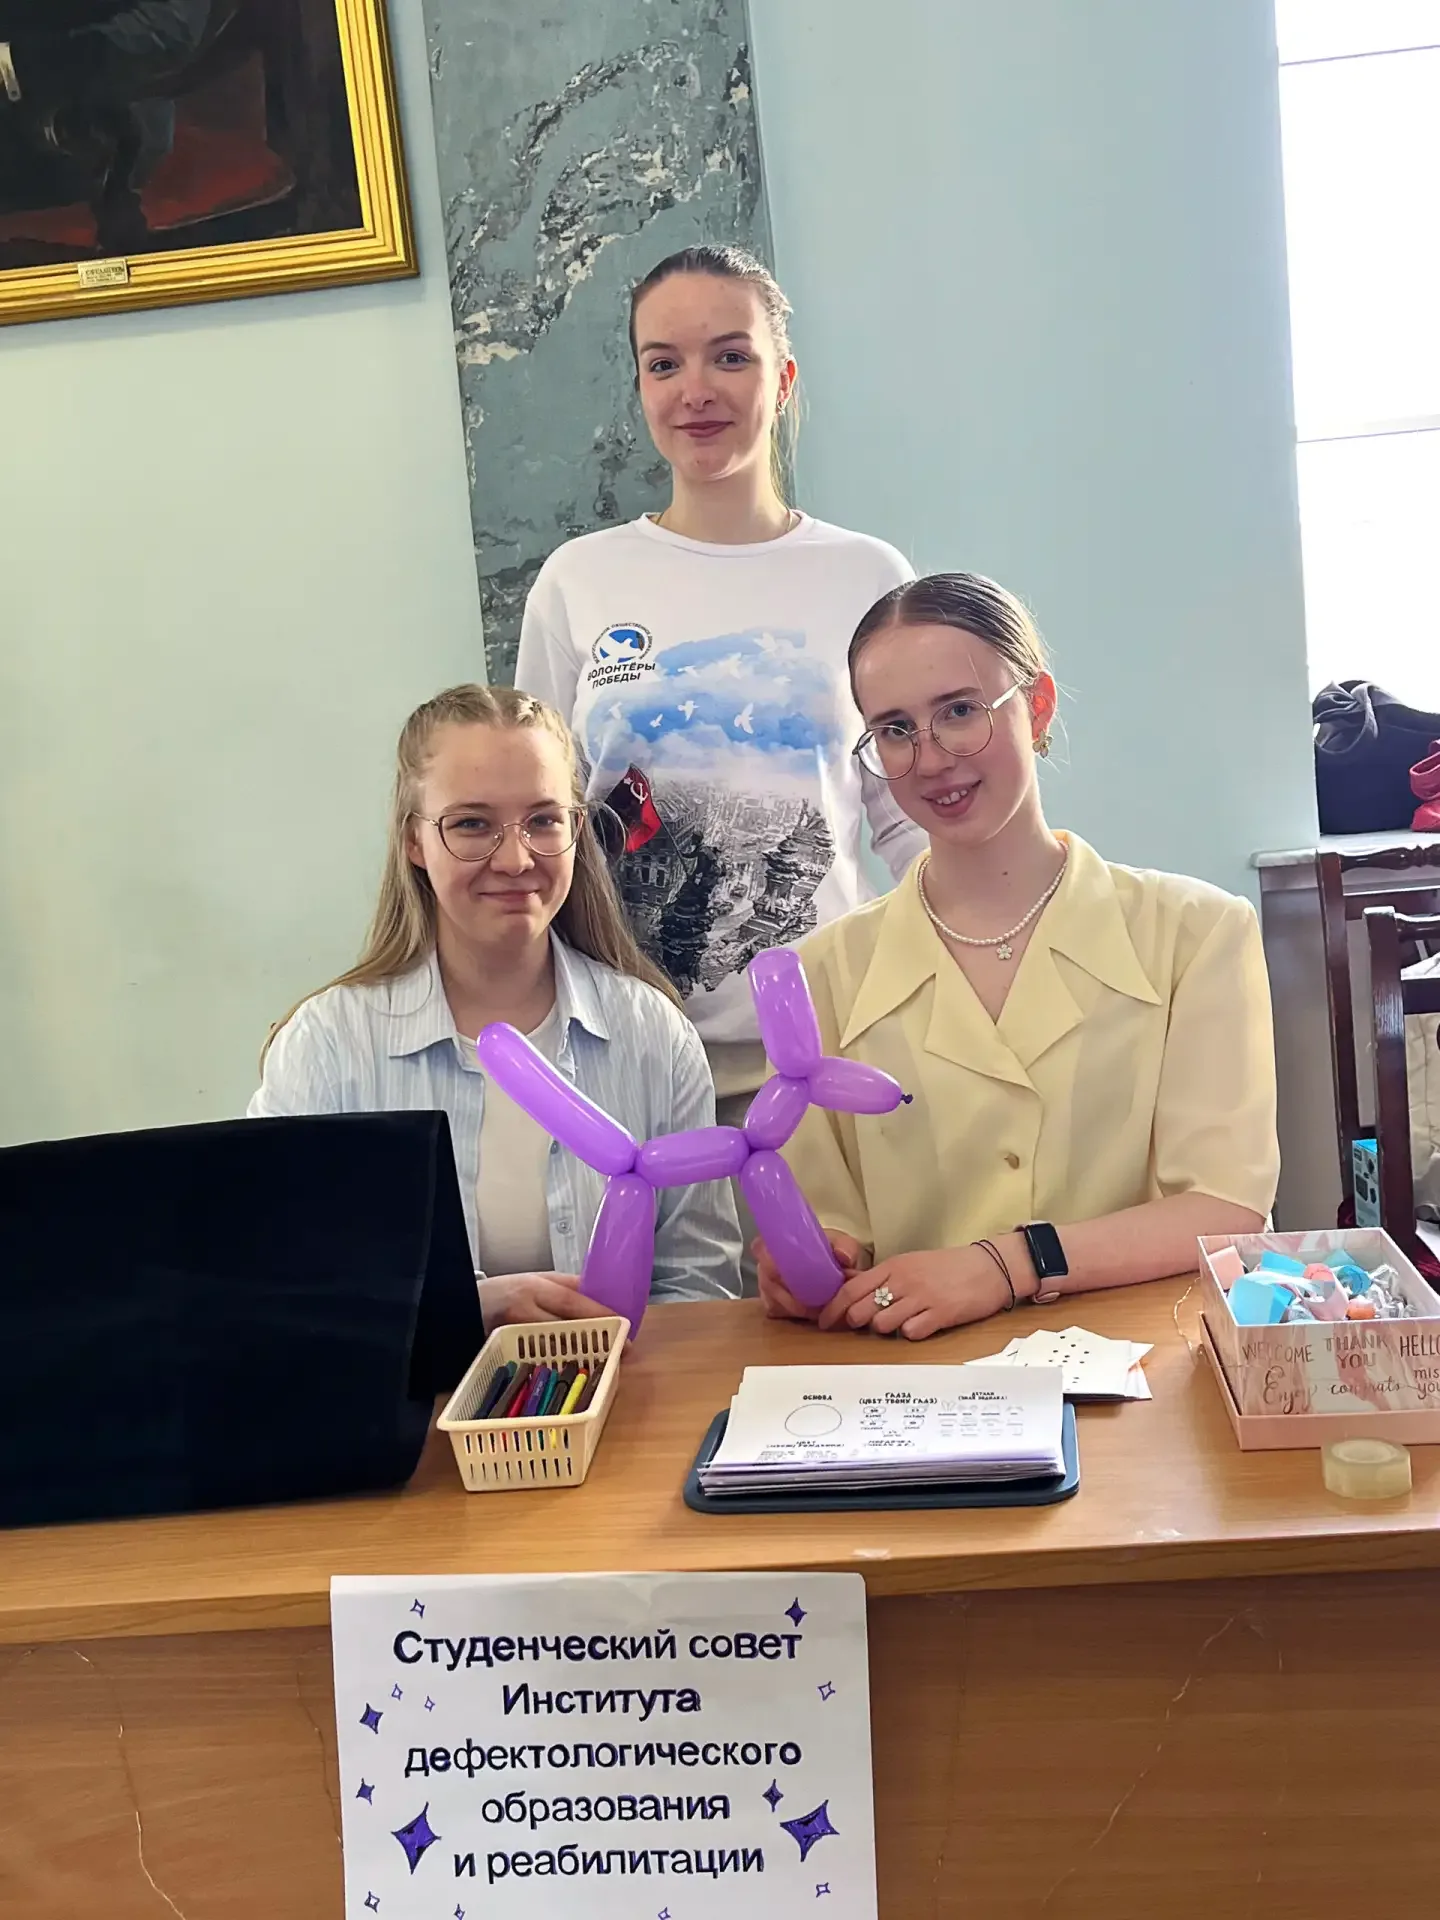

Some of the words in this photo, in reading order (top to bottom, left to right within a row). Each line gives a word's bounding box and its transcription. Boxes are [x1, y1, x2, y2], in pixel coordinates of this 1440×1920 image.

[587, 662, 656, 681] ВОЛОНТЁРЫ
[592, 672, 641, 689] ПОБЕДЫ
[1242, 1341, 1315, 1363] WELCOME
[1325, 1335, 1388, 1353] THANK
[1336, 1353, 1376, 1369] YOU
[1331, 1375, 1400, 1400] conrats
[394, 1629, 677, 1671] Студенческий
[689, 1632, 803, 1659] совет
[502, 1683, 702, 1722] Института
[404, 1738, 802, 1777] дефектологического
[481, 1790, 730, 1829] образования
[453, 1852, 476, 1877] и
[487, 1843, 765, 1884] реабилитации
